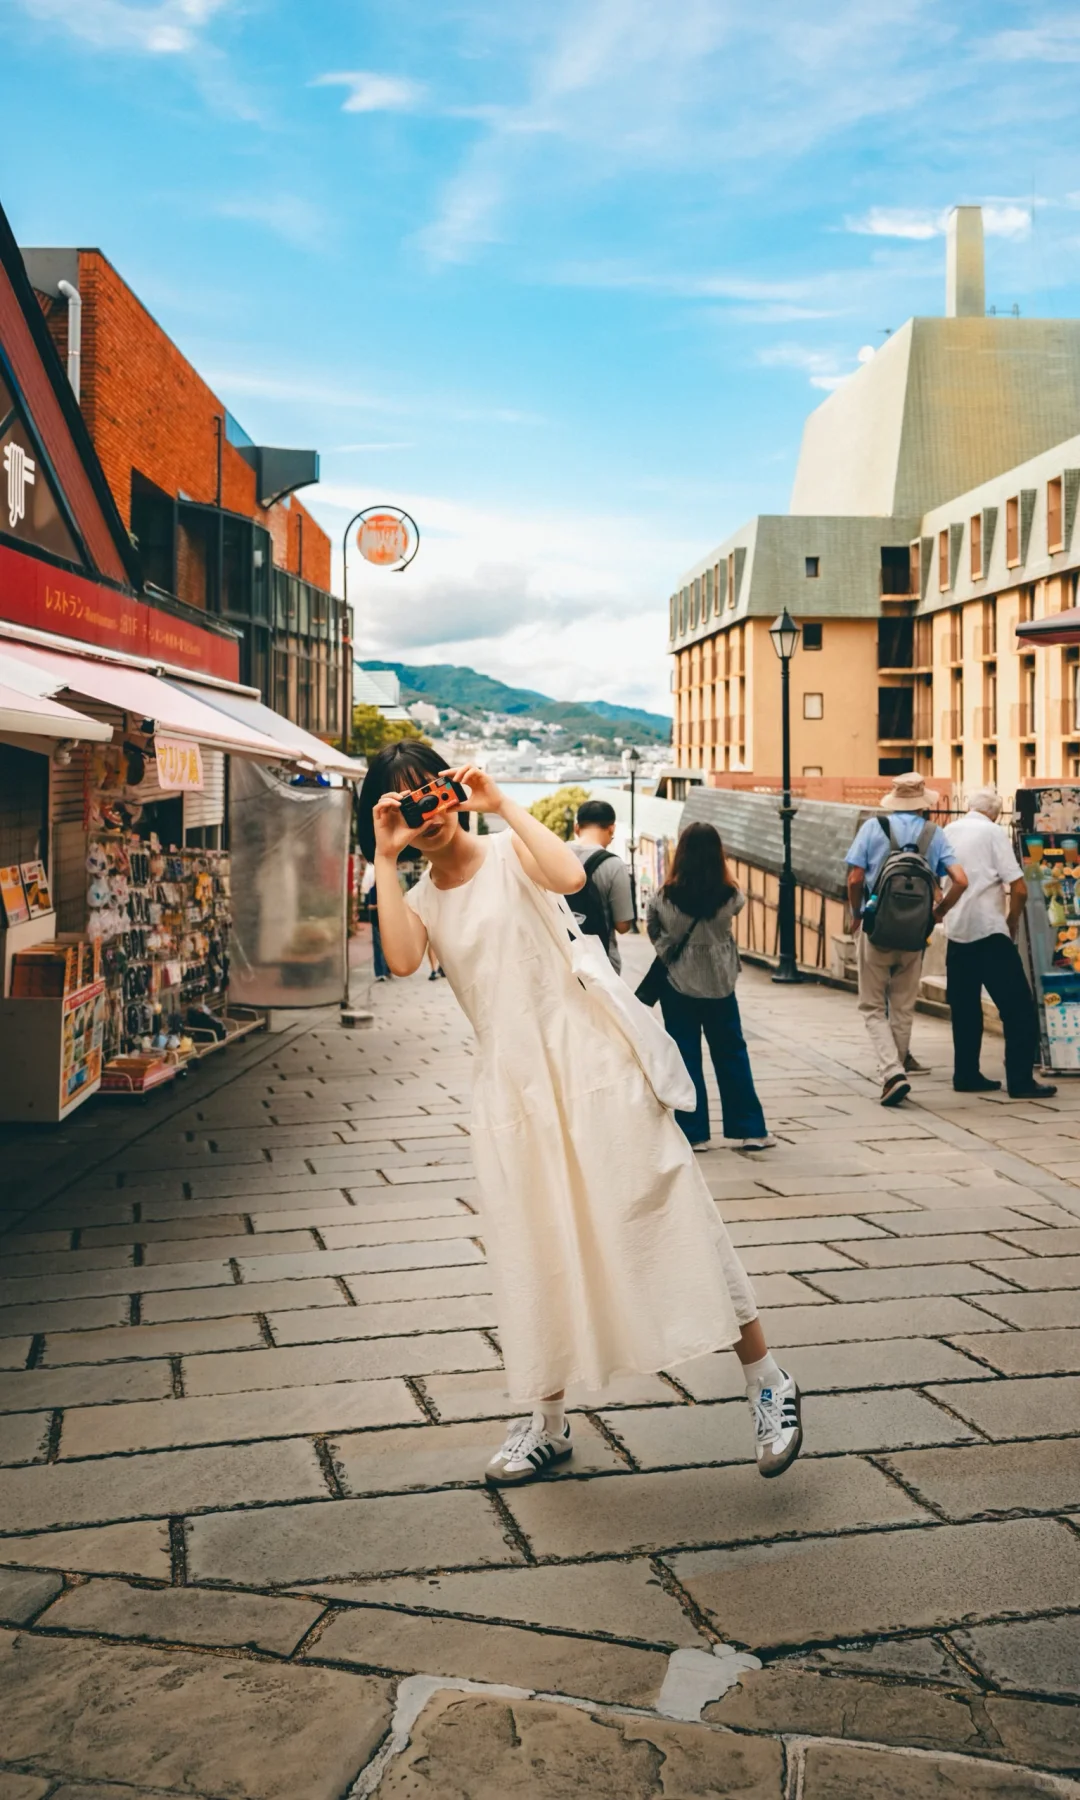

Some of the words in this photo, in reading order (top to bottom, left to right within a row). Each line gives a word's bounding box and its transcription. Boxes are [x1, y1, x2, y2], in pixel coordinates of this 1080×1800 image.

[45, 585, 84, 618] レストラン
